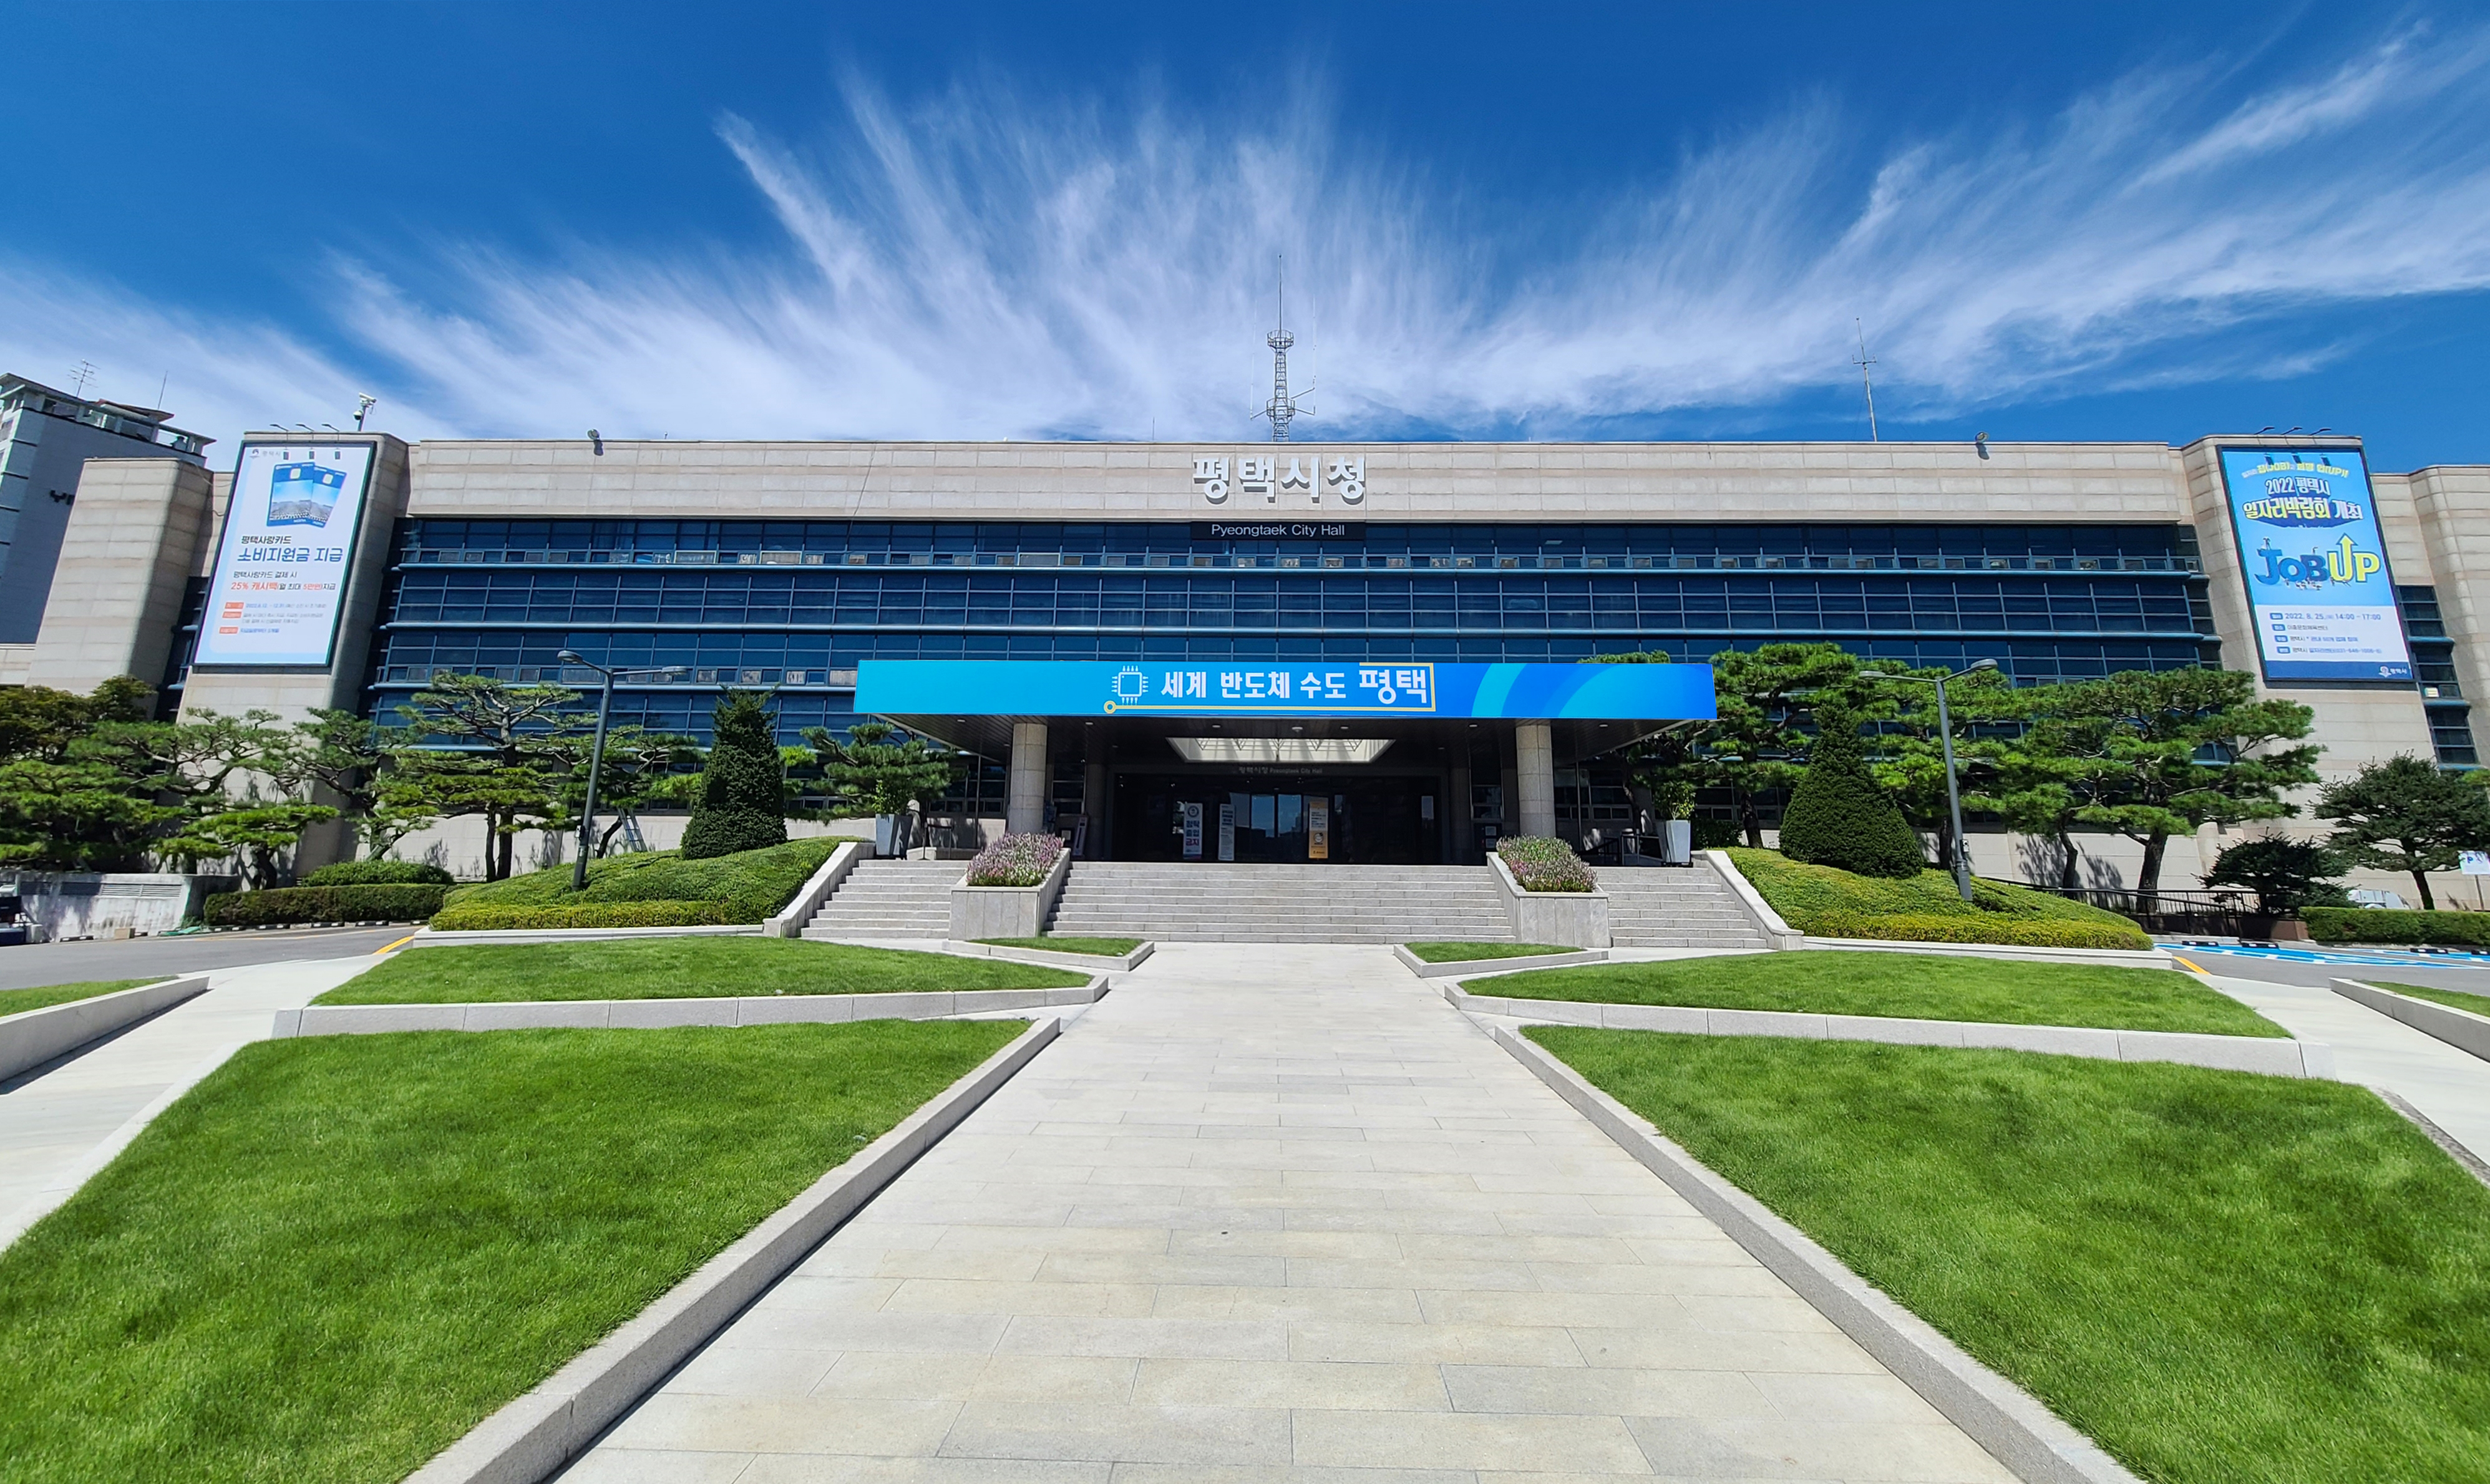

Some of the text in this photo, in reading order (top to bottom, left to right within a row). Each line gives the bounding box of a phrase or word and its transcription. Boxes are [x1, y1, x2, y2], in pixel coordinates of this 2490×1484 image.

[1193, 456, 1365, 503] 평택시청
[2265, 477, 2330, 495] 2022 평택시
[2243, 497, 2363, 519] 일자리박람회 개최
[1212, 524, 1345, 537] Pyeongtaek City Hall
[241, 536, 291, 544] 평택사랑카드
[237, 548, 343, 562] 소비지원금 지급
[231, 582, 249, 590] 25%
[1161, 669, 1426, 704] 세계 반도체 수도 평택
